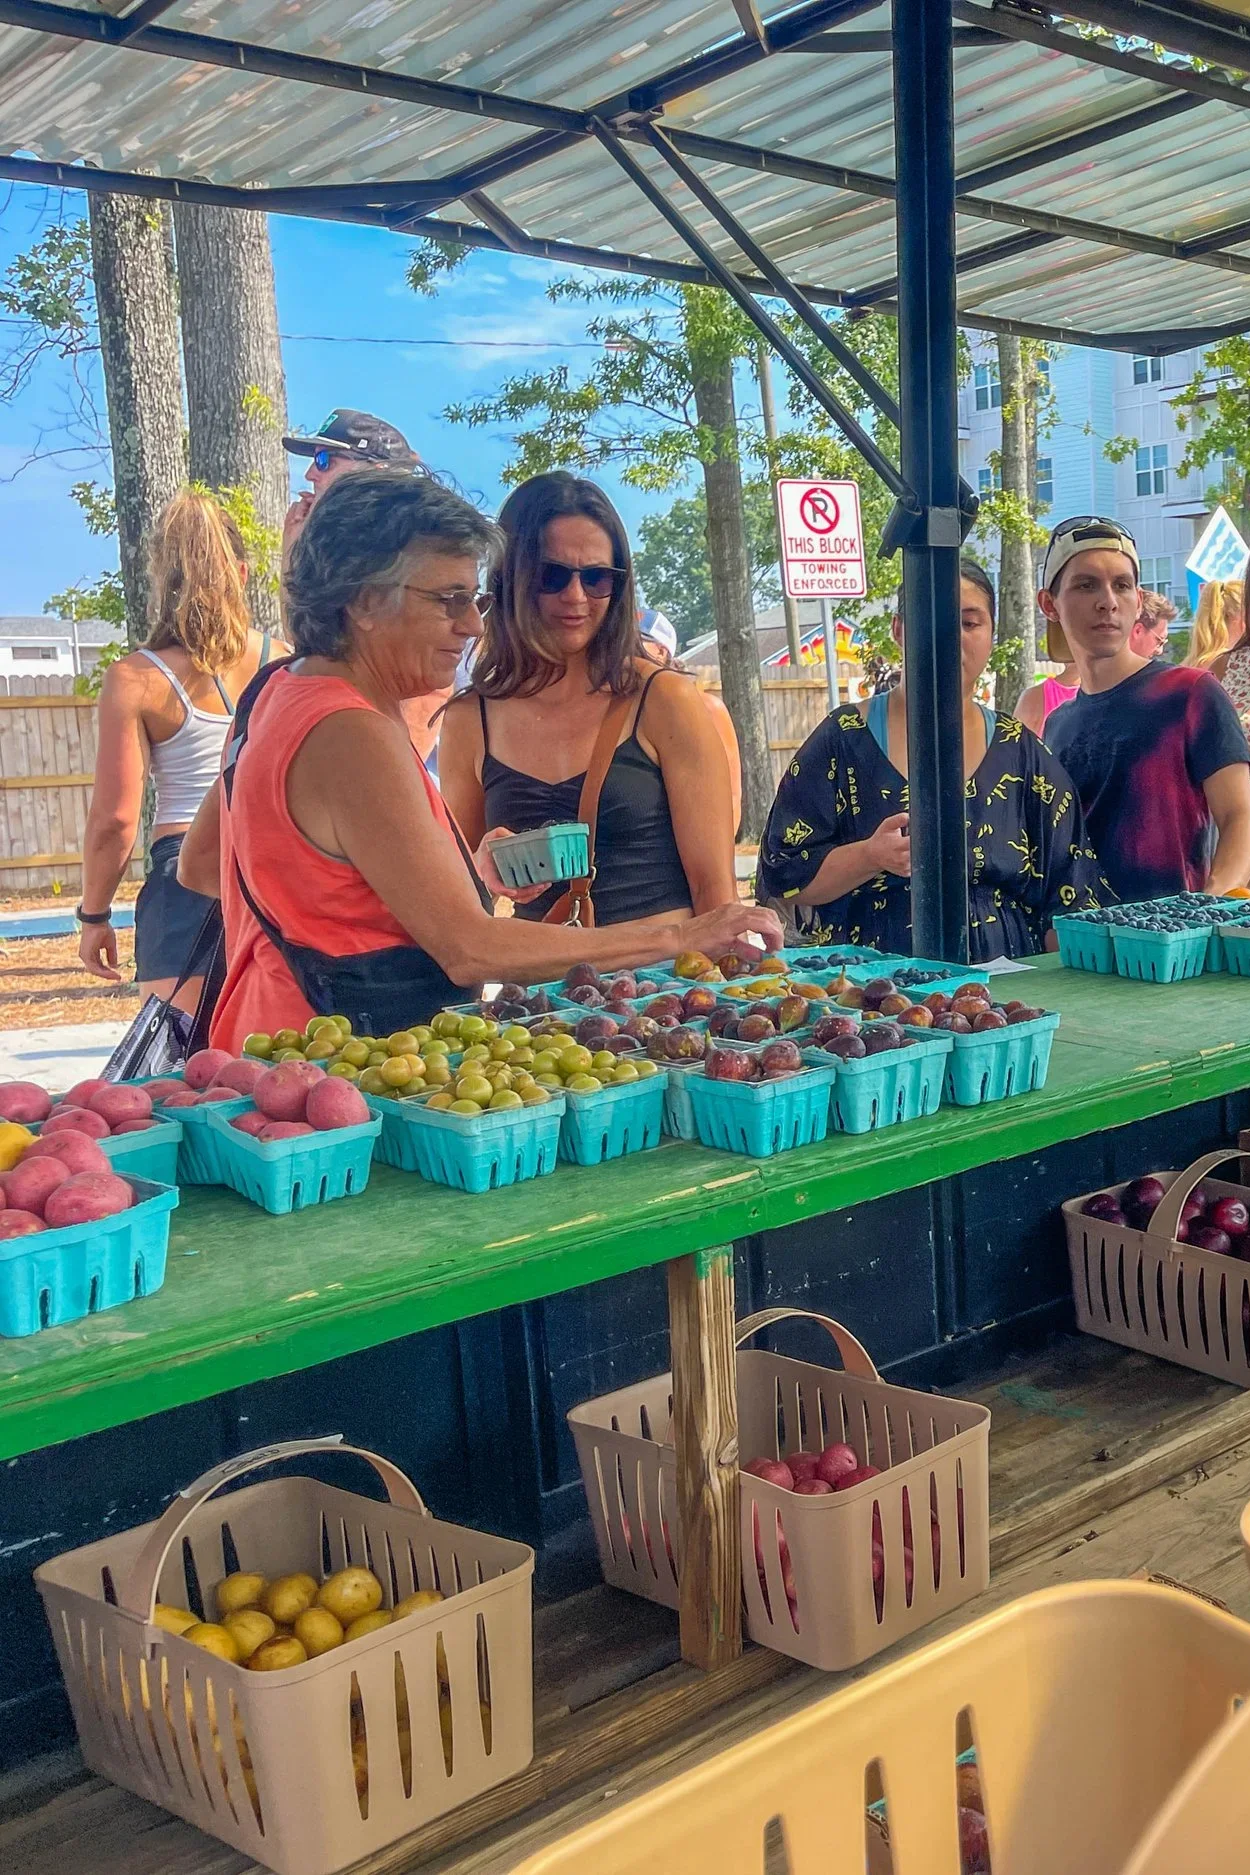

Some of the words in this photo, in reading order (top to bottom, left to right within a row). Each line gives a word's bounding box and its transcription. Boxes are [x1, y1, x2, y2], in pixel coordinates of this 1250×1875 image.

[787, 537, 815, 554] THIS
[819, 537, 858, 554] BLOCK
[802, 563, 847, 574] TOWING
[794, 578, 858, 590] ENFORCED
